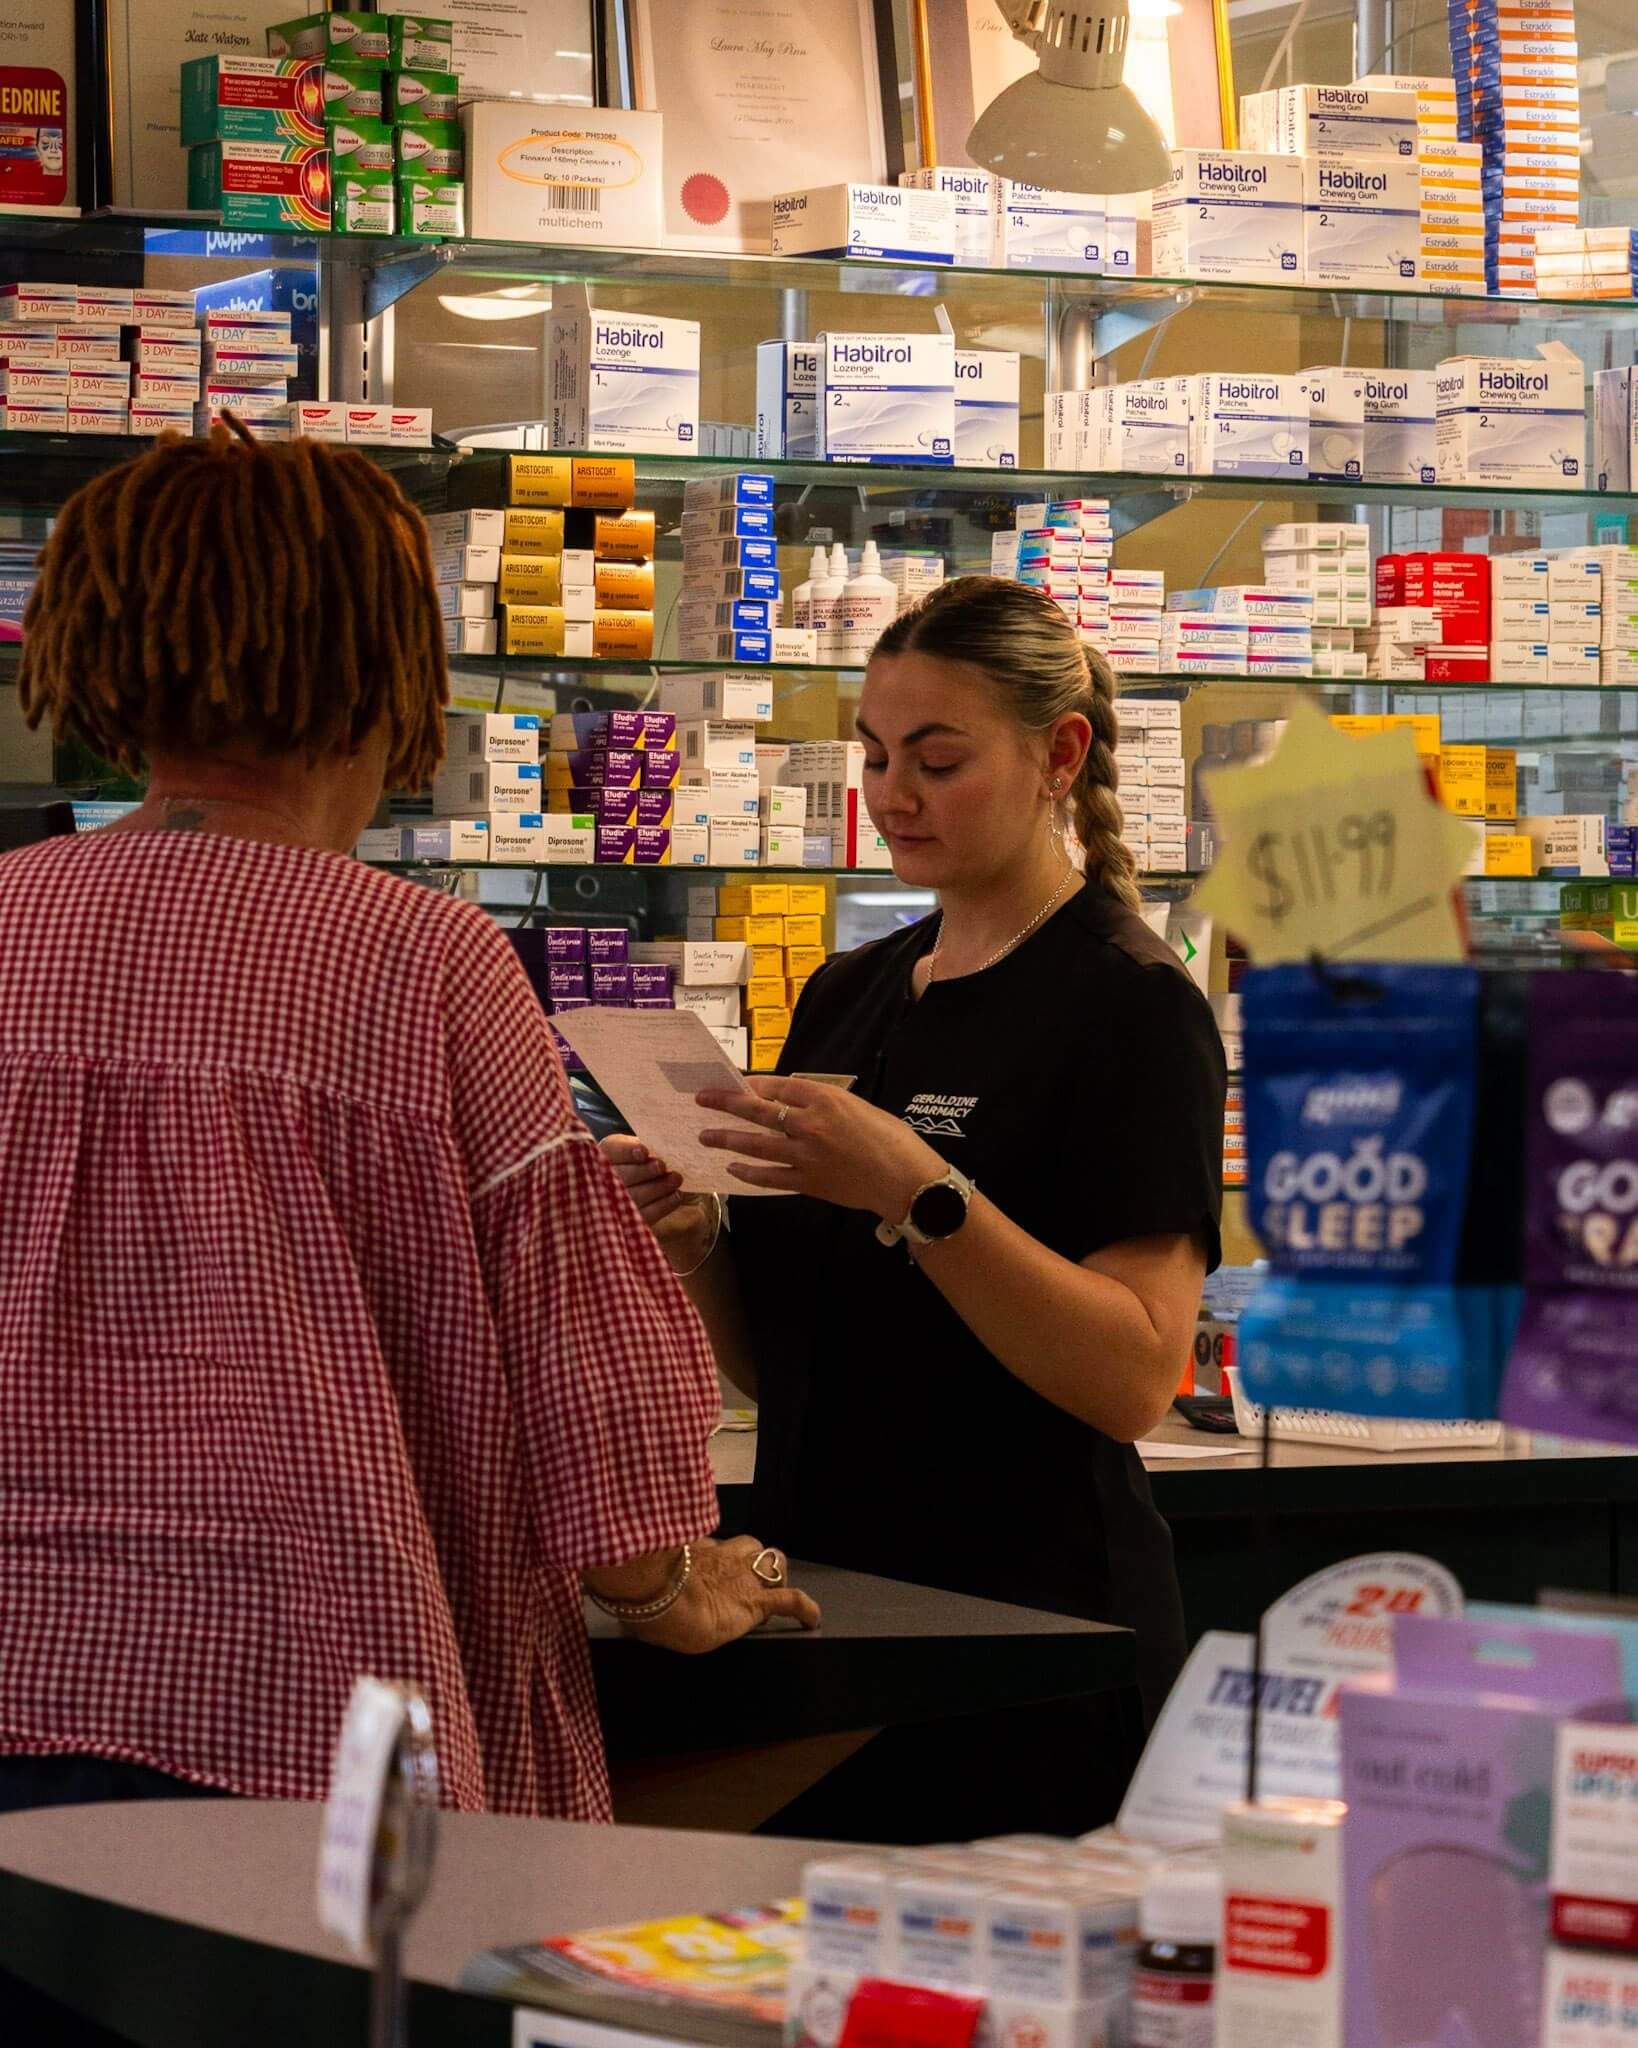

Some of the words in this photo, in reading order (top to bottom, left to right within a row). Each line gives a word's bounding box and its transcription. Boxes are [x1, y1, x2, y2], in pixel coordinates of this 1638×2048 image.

[185, 29, 209, 42] Kate
[212, 32, 250, 48] Watson
[1318, 88, 1368, 104] Habitrol
[2, 88, 62, 116] EDRINE
[1318, 103, 1346, 112] Chewing
[1318, 122, 1326, 132] 2
[532, 129, 560, 137] Product
[1198, 162, 1266, 183] Habitrol
[1319, 170, 1386, 191] Habitrol
[1199, 182, 1236, 194] Chewing
[1238, 182, 1258, 192] Gum
[853, 188, 902, 206] Habitrol
[1012, 193, 1042, 202] Patches
[1319, 188, 1356, 200] Chewing
[1358, 190, 1378, 200] Gum
[774, 196, 808, 213] Habitrol
[1200, 208, 1208, 220] 2
[538, 217, 604, 230] multichem
[1012, 216, 1024, 227] 14
[1320, 214, 1328, 226] 2
[852, 230, 861, 242] 2
[774, 238, 780, 251] 2
[1282, 255, 1296, 264] 204
[1400, 263, 1414, 272] 204
[21, 304, 28, 314] 3
[31, 303, 50, 314] DAY
[136, 308, 143, 318] 3
[147, 308, 167, 318] DAY
[211, 329, 220, 340] 6
[222, 329, 246, 340] DAY
[596, 326, 664, 349] Habitrol
[144, 346, 150, 356] 3
[154, 346, 174, 356] DAY
[596, 347, 632, 358] Lozenge
[834, 345, 912, 363] Habitrol
[219, 361, 227, 372] 6
[229, 361, 254, 374] DAY
[833, 363, 874, 374] Lozenge
[12, 376, 18, 386] 3
[22, 376, 42, 386] DAY
[73, 379, 80, 390] 3
[82, 379, 103, 390] DAY
[596, 373, 601, 386] 1
[1436, 376, 1464, 392] Habitrol
[1480, 372, 1548, 391] Habitrol
[1219, 383, 1278, 400] Habitrol
[1480, 390, 1516, 402] Chewing
[1518, 391, 1540, 400] Gum
[210, 395, 218, 406] 6
[221, 395, 244, 406] DAY
[834, 394, 843, 406] 2
[1126, 394, 1168, 411] Habitrol
[1219, 400, 1248, 408] Patches
[1380, 400, 1400, 409] Gum
[10, 413, 16, 422] 3
[20, 413, 40, 424] DAY
[135, 418, 142, 428] 3
[145, 418, 165, 428] DAY
[1480, 415, 1488, 428] 2
[1219, 422, 1230, 433] 14
[516, 465, 554, 474] ARISTOCORT
[577, 466, 616, 476] ARISTOCORT
[1346, 463, 1358, 472] 28
[510, 516, 547, 526] ARISTOCORT
[506, 564, 544, 574] ARISTOCORT
[512, 616, 548, 625] ARISTOCORT
[598, 618, 636, 627] ARISTOCORT
[1182, 632, 1190, 642] 6
[1192, 632, 1210, 642] DAY
[1179, 661, 1186, 671] 6
[1188, 661, 1208, 672] DAY
[614, 713, 636, 722] Efudix
[644, 716, 666, 724] Efudix
[490, 736, 526, 748] Diprosone
[610, 752, 632, 760] Efudix
[649, 752, 672, 760] Efudix
[494, 786, 530, 798] Diprosone
[604, 790, 628, 799] Efudix
[640, 791, 662, 800] Efudix
[601, 829, 624, 837] Efudix
[638, 829, 661, 838] Efudix
[495, 836, 531, 847] Diprosone
[548, 836, 584, 848] Diprosone
[912, 1094, 979, 1108] GERALDINE
[904, 1104, 972, 1118] PHARMACY
